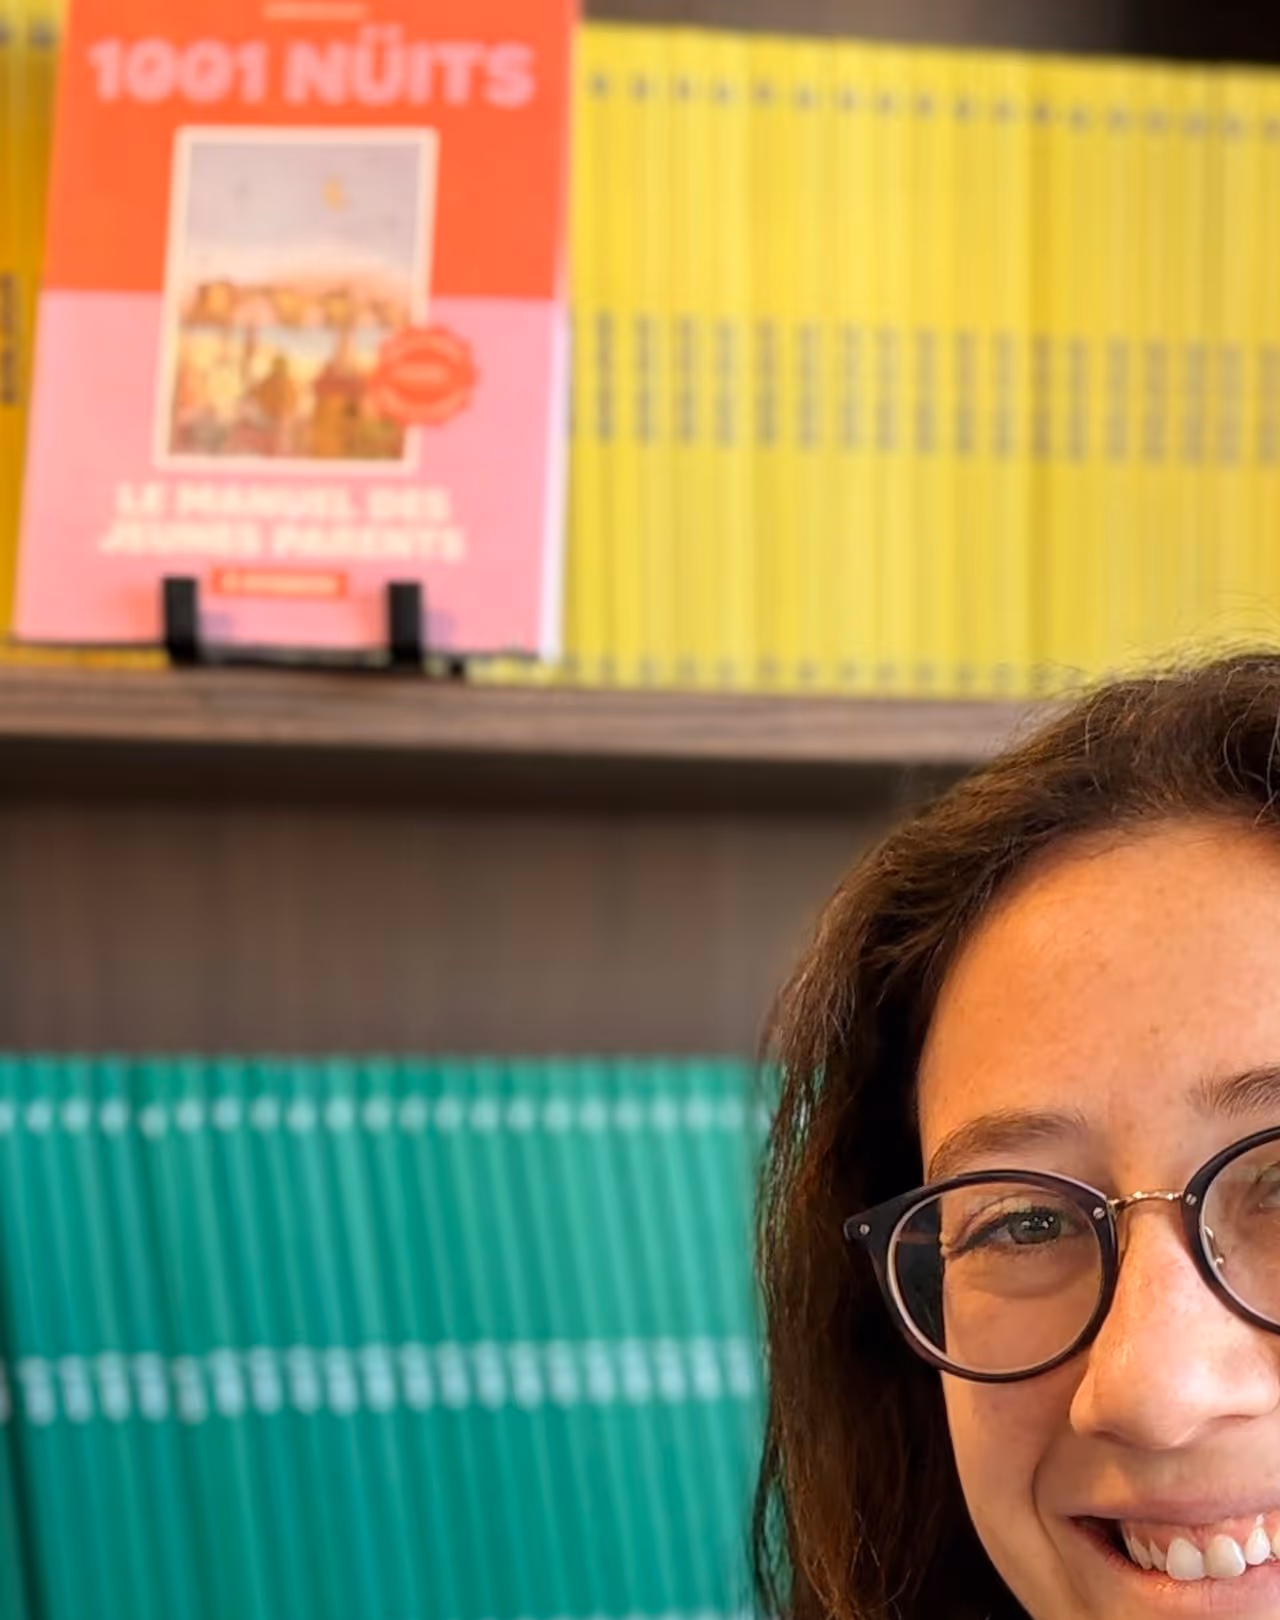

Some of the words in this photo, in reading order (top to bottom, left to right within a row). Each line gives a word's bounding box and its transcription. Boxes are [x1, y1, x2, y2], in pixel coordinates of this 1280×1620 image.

[88, 37, 268, 104] 1001
[116, 482, 166, 516] LE
[366, 486, 452, 523] DES
[271, 523, 465, 562] PARENTS
